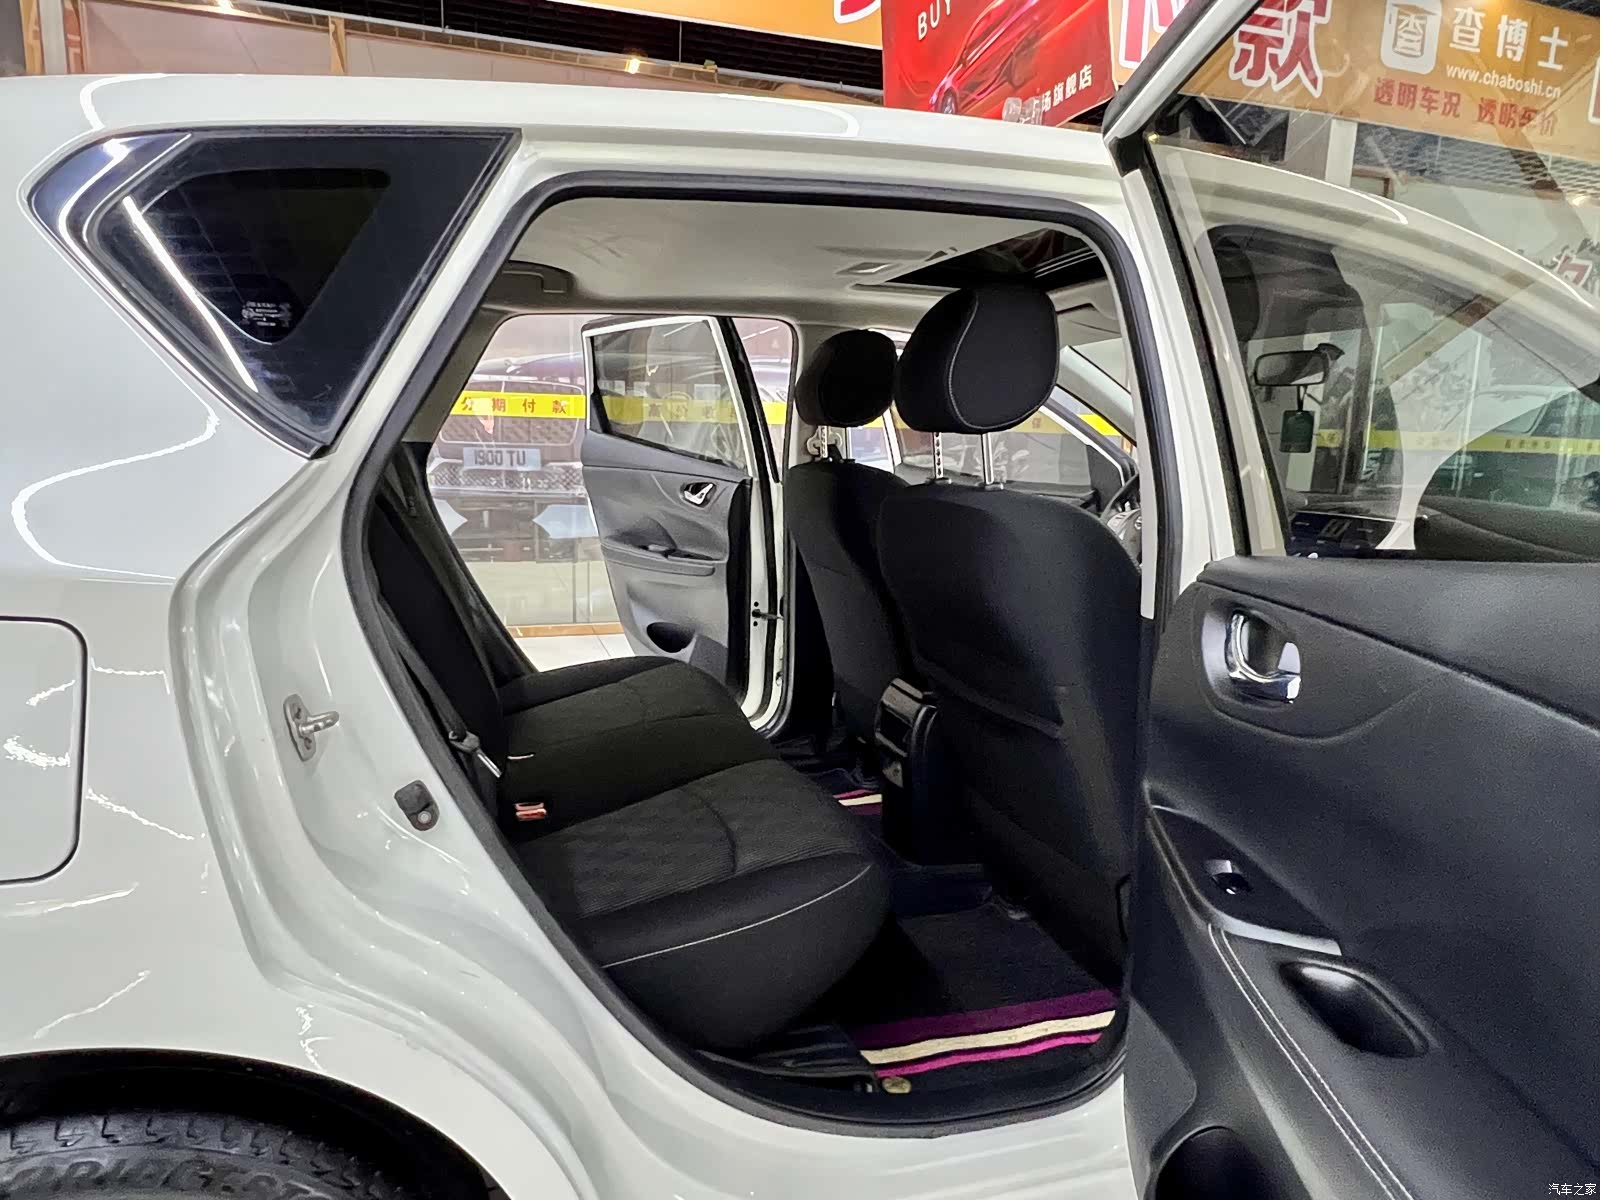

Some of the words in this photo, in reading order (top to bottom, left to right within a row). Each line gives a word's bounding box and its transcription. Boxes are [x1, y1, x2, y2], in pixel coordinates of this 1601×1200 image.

[1449, 6, 1568, 71] 查博士
[1374, 76, 1461, 118] 透明车况
[1446, 64, 1562, 99] www.chaboshi.cn
